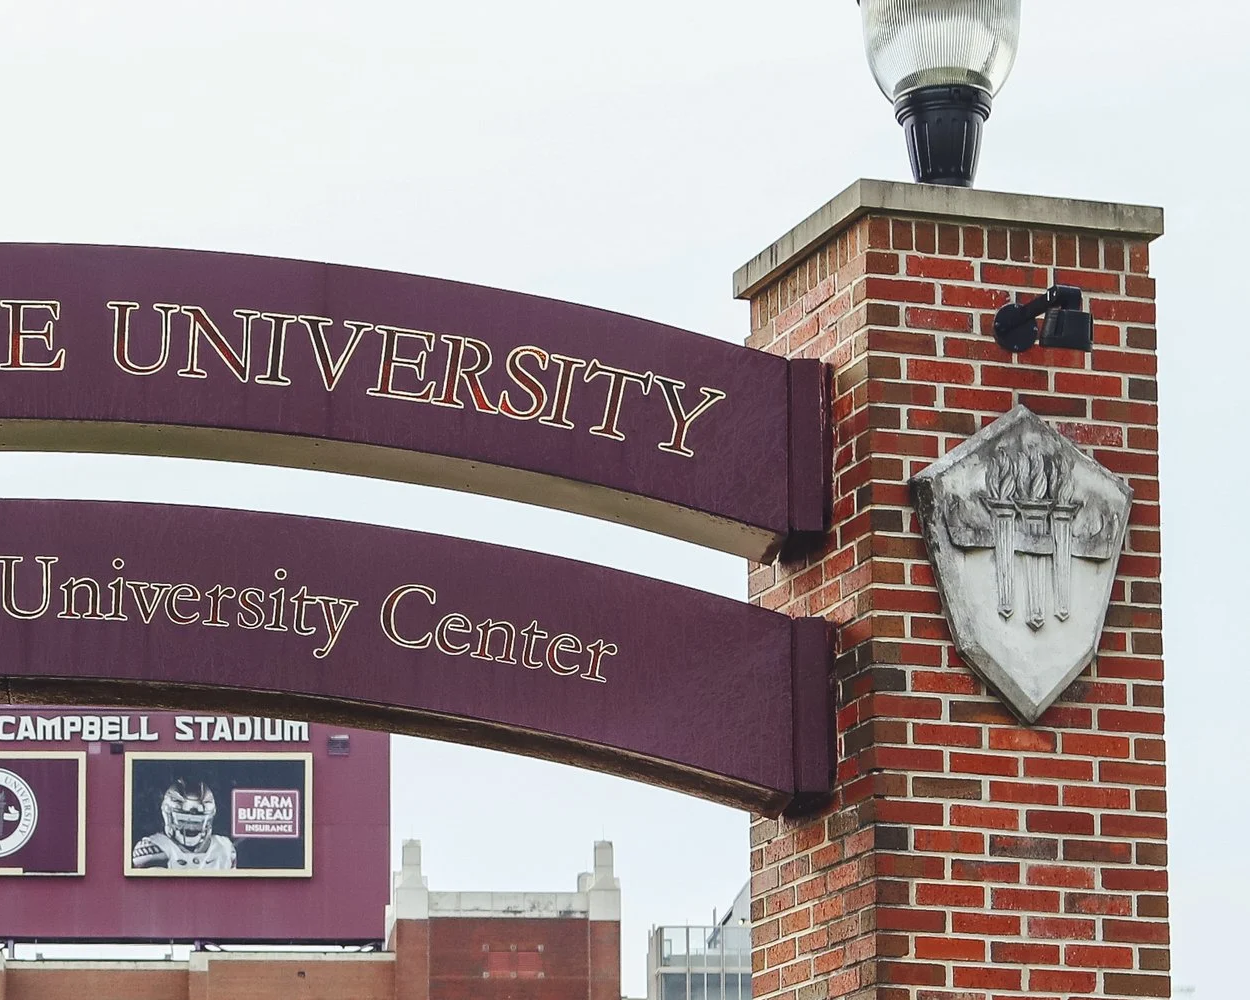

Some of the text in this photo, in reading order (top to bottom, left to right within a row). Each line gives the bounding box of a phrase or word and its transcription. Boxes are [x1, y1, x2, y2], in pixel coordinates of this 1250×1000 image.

[107, 301, 726, 457] UNIVERSITY
[380, 584, 618, 683] Center
[174, 715, 310, 742] STADIUM
[3, 774, 32, 837] UNIVERSITY
[238, 808, 293, 821] BUREAU
[254, 795, 293, 808] FARM
[245, 824, 293, 833] INSURANCE
